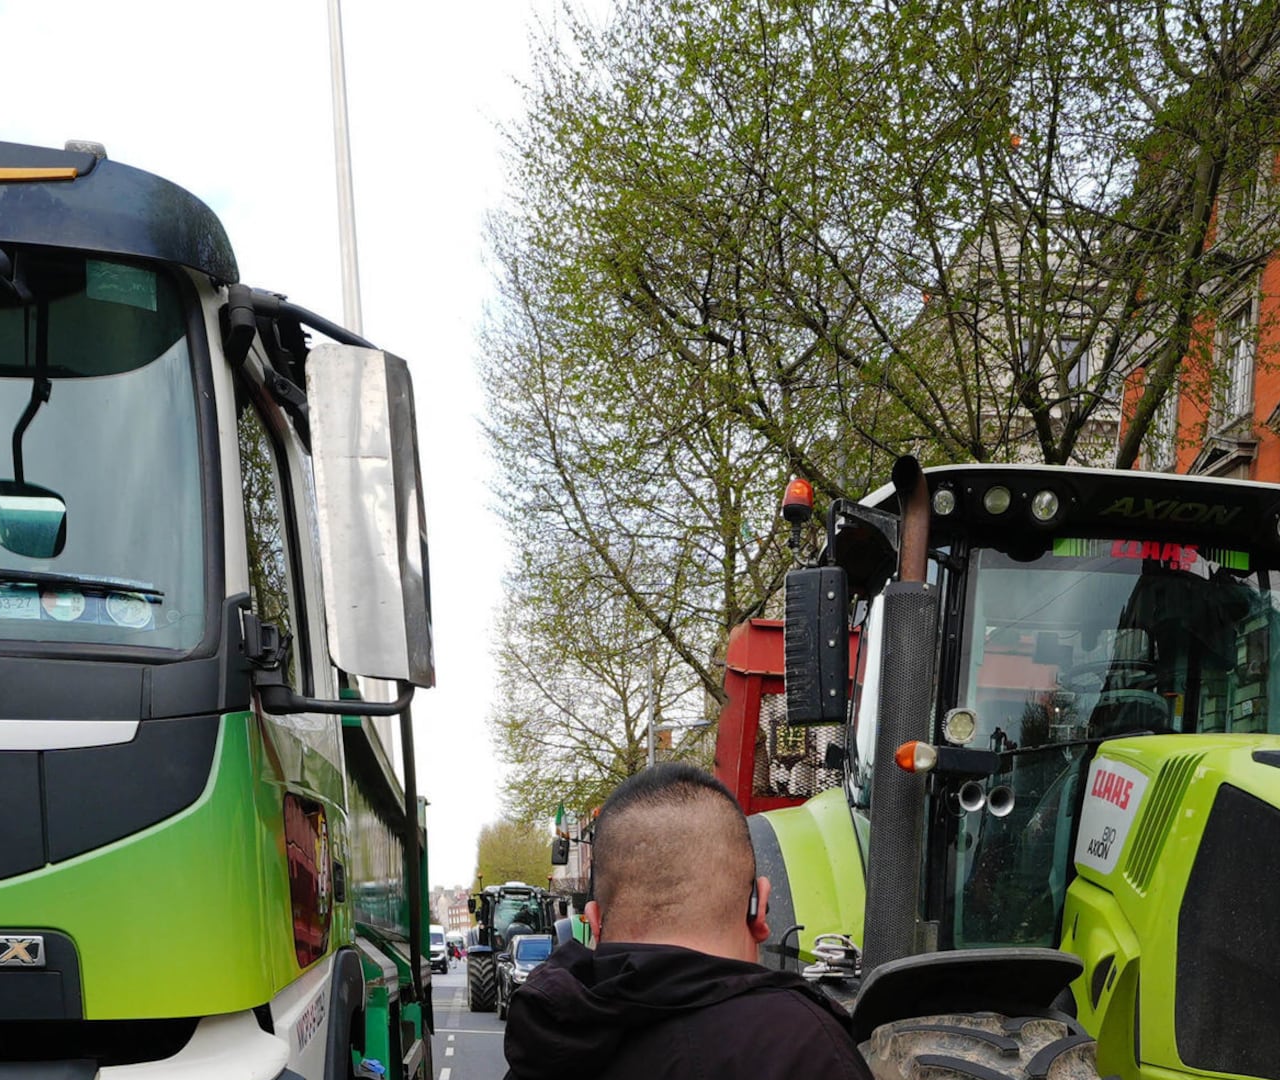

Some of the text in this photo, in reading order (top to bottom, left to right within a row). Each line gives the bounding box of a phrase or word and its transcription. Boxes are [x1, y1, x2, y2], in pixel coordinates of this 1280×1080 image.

[1099, 497, 1242, 524] AXION
[1111, 539, 1200, 563] CLAAS
[1091, 769, 1135, 811] CLAAS
[1087, 838, 1111, 861] AXION
